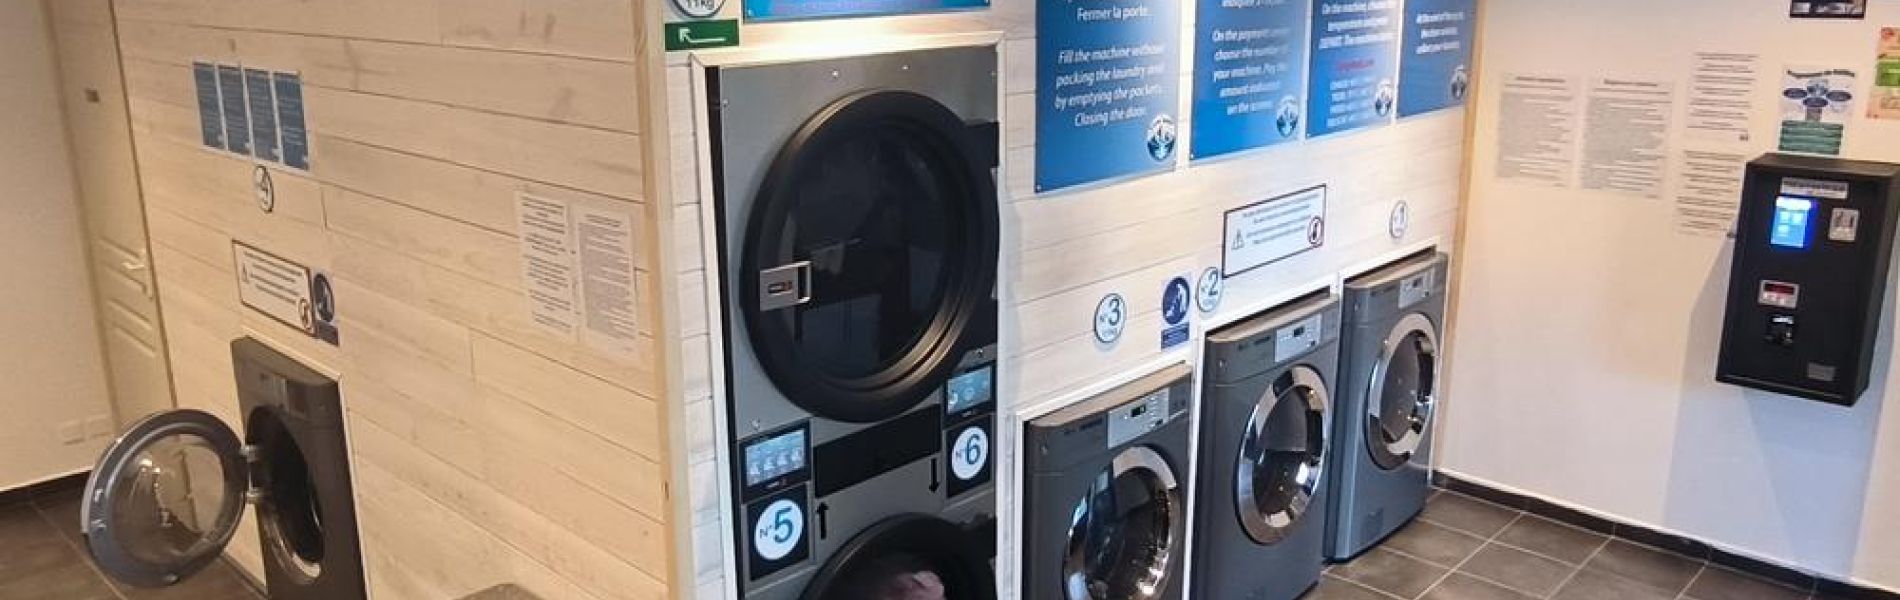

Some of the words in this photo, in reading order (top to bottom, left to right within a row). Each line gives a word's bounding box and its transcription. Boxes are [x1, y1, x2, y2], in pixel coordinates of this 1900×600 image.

[1076, 7, 1110, 21] Fermer
[1112, 5, 1121, 19] la
[1058, 49, 1073, 64] Fill
[1074, 48, 1090, 62] the
[1091, 46, 1130, 60] machine
[1132, 43, 1164, 56] without
[1056, 71, 1095, 89] packing
[1096, 68, 1110, 82] the
[1112, 65, 1144, 80] laundry
[1054, 94, 1067, 111] by
[1068, 90, 1112, 107] emptying
[1113, 87, 1127, 100] the
[1075, 110, 1108, 127] Closing
[1109, 108, 1124, 121] the
